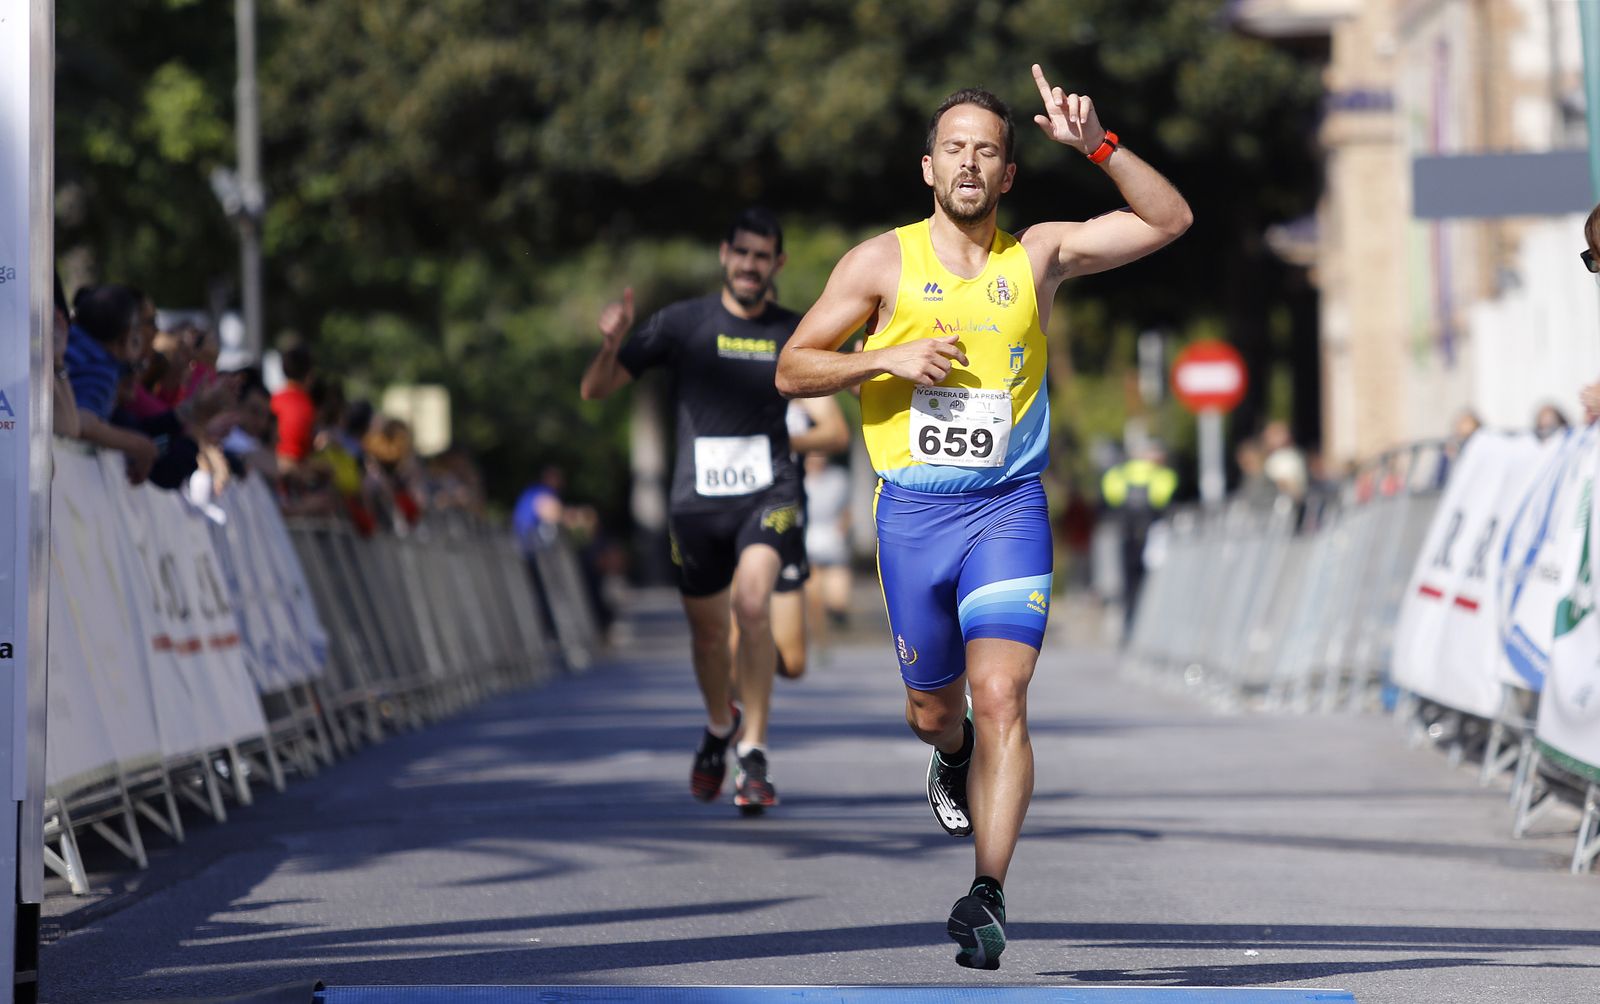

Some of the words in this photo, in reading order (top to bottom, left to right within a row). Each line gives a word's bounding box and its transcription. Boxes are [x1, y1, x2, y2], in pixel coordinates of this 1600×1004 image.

[925, 390, 957, 398] CARRERA
[918, 425, 993, 458] 659
[706, 467, 756, 489] 806
